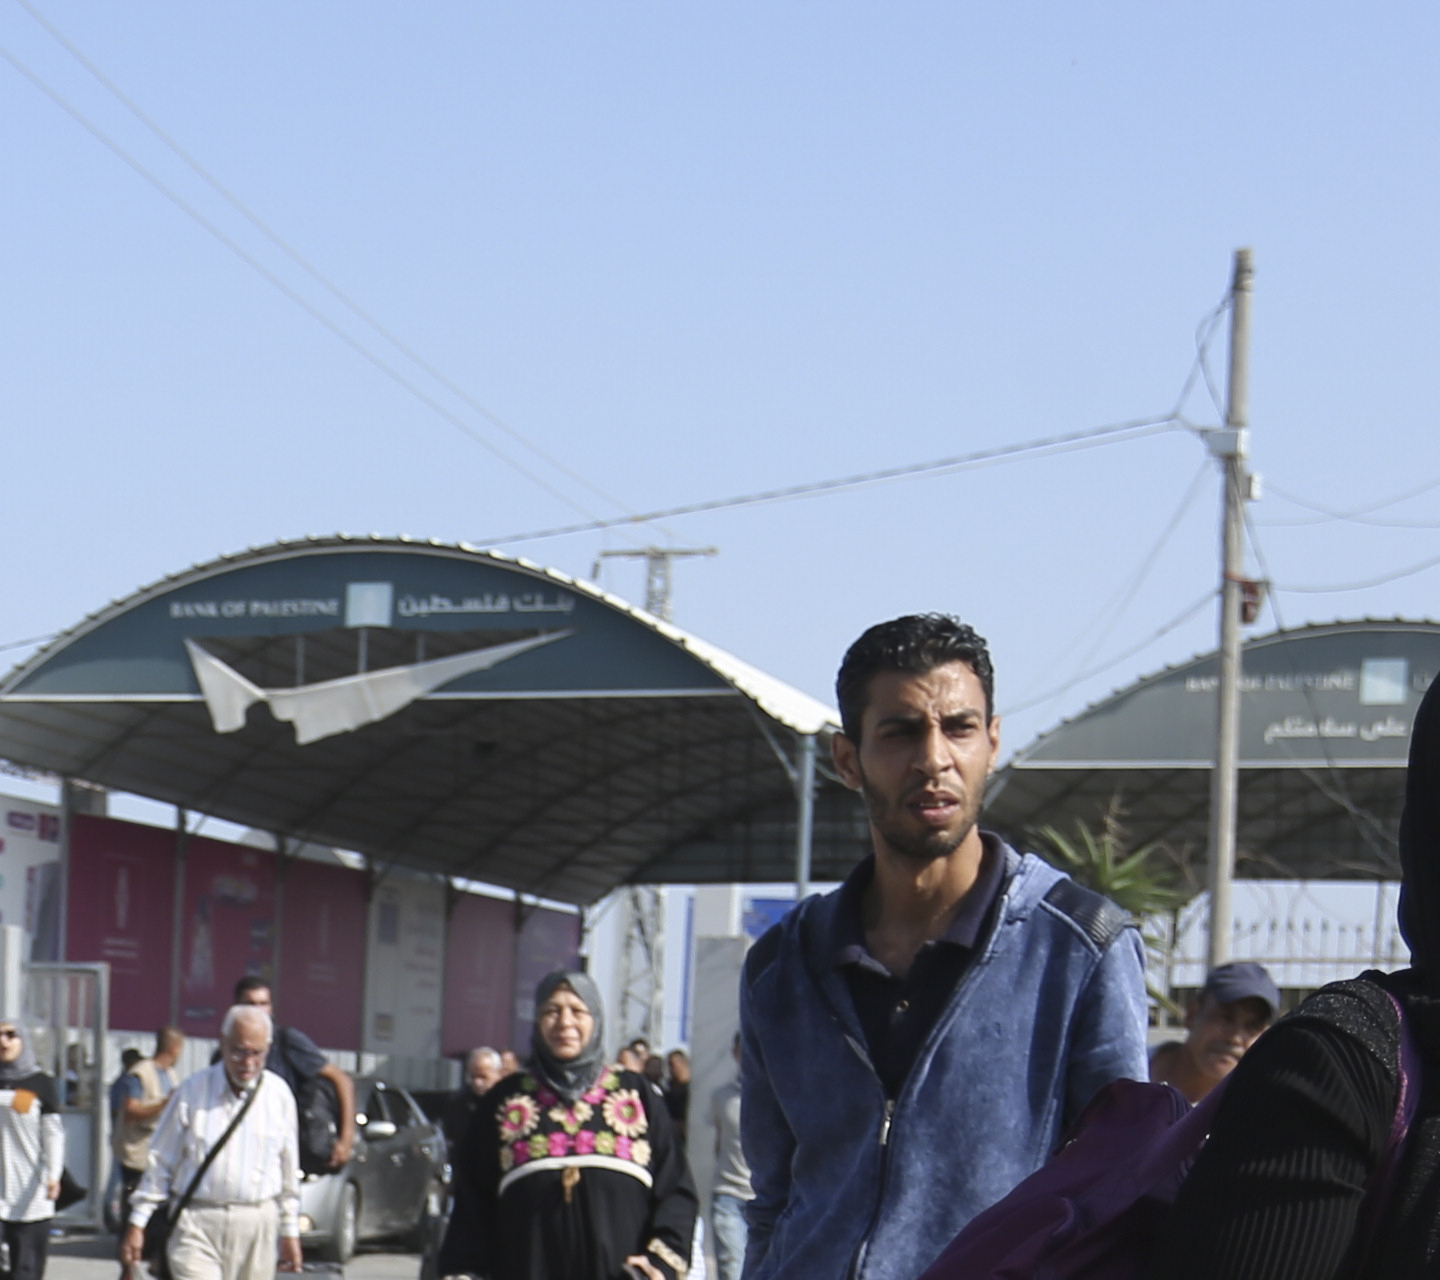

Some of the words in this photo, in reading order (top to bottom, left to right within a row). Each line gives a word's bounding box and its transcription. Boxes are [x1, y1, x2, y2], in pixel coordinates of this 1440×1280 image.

[169, 602, 219, 618] BANK
[221, 600, 246, 618] OF
[250, 598, 339, 617] PALESTINE
[396, 594, 511, 618] فلسطين
[1185, 676, 1219, 692] BAN
[1264, 672, 1355, 691] PALESTINE
